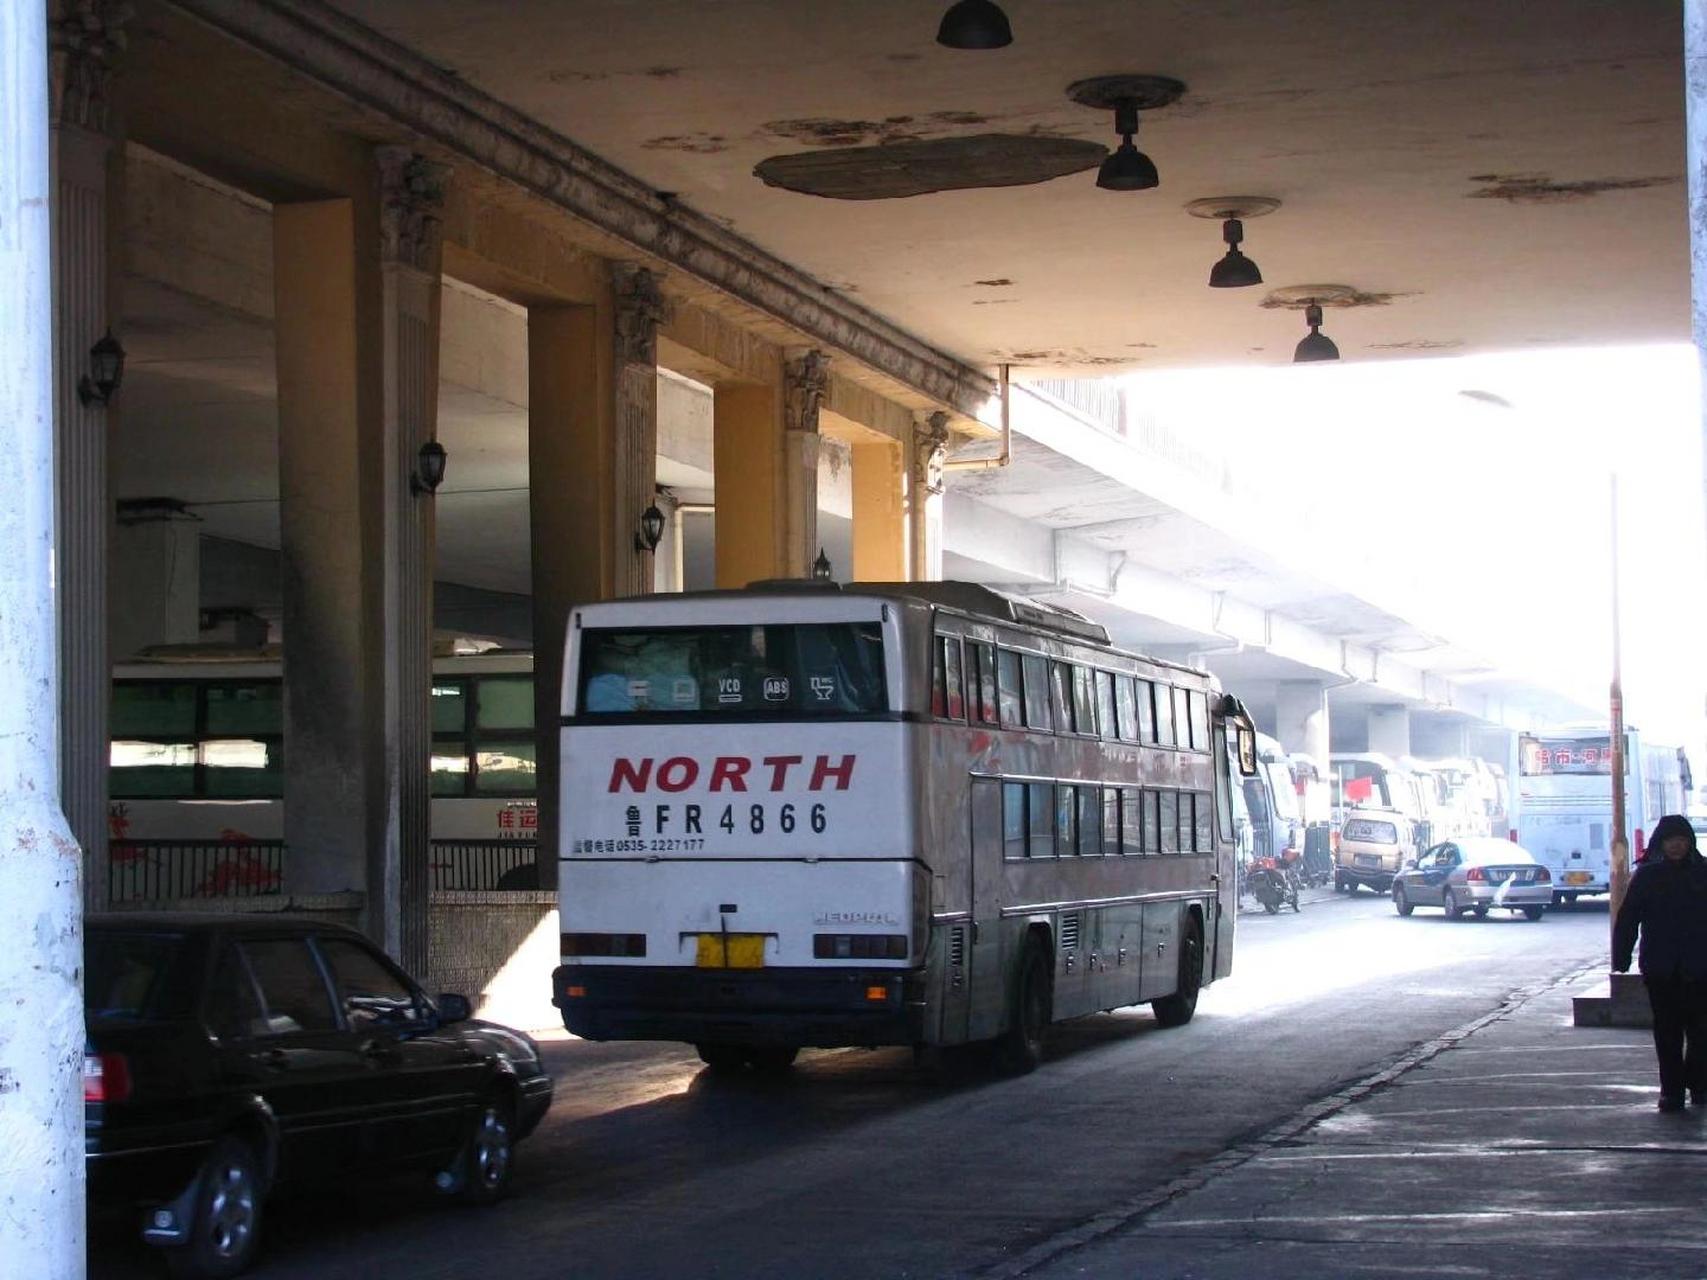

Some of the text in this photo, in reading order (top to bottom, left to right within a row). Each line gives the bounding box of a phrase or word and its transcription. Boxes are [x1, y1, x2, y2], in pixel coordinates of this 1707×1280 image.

[719, 679, 741, 693] VCD
[766, 680, 788, 694] ABS
[607, 754, 857, 793] NORTH
